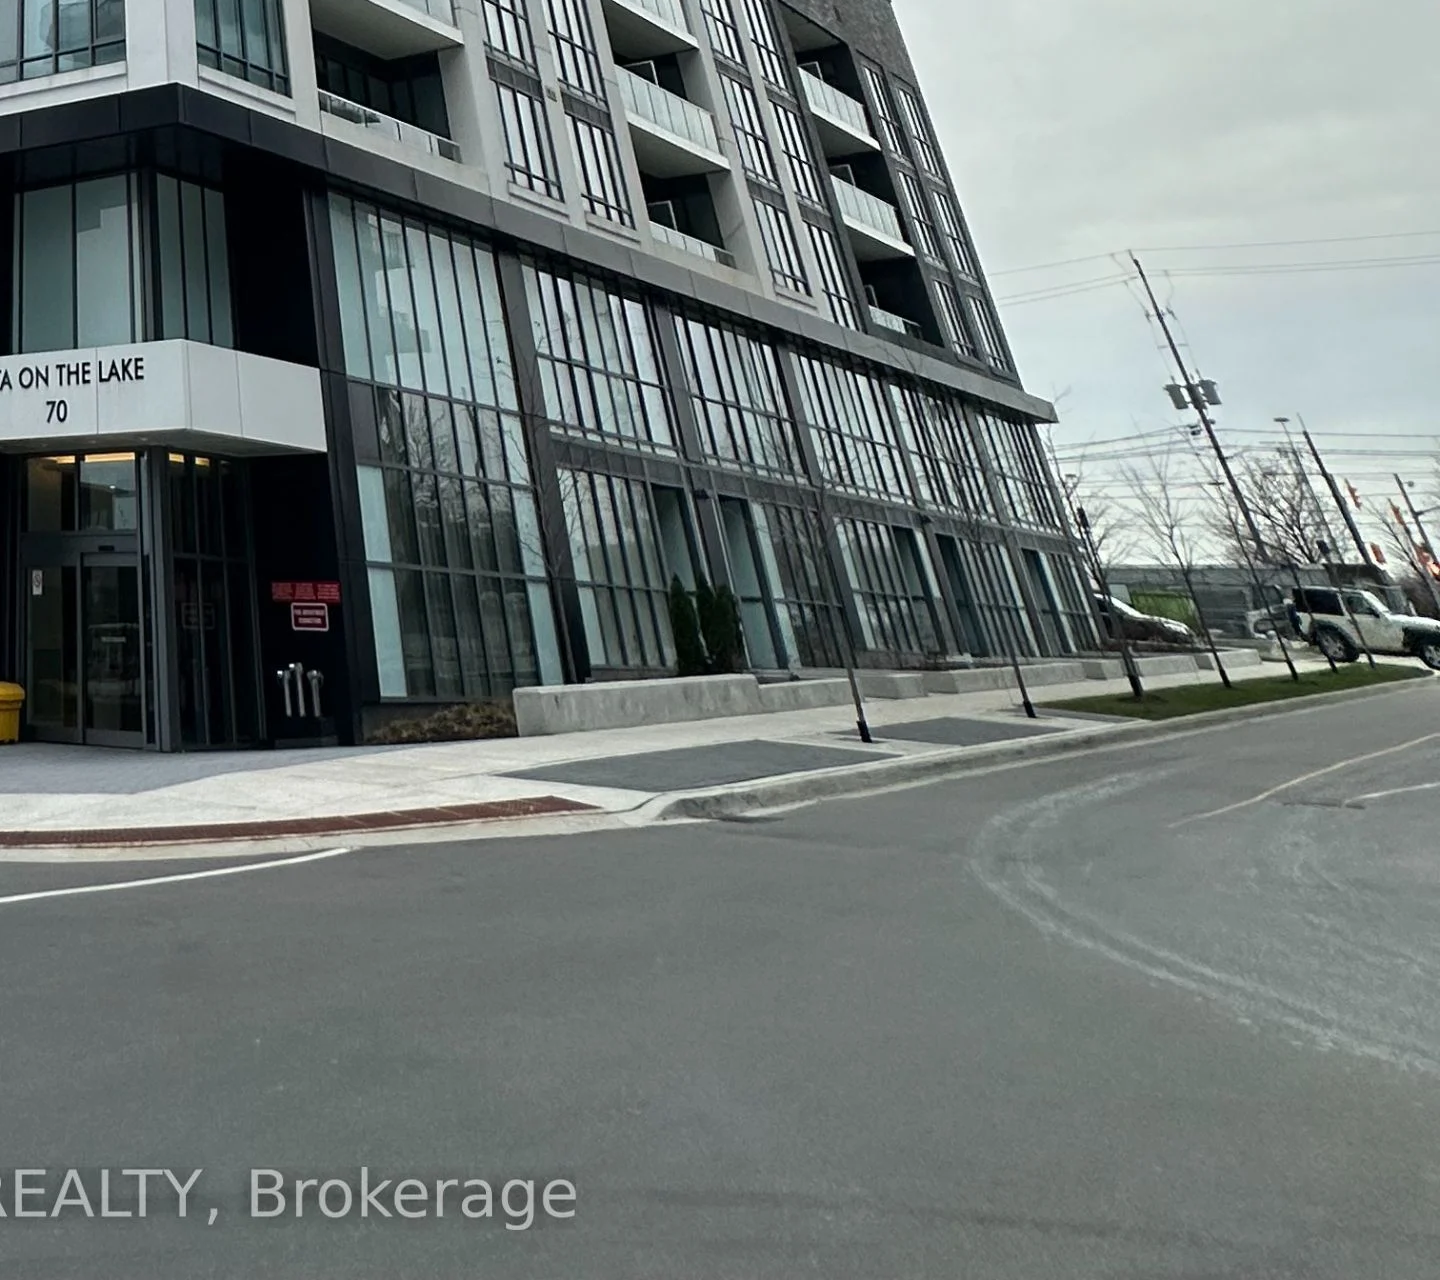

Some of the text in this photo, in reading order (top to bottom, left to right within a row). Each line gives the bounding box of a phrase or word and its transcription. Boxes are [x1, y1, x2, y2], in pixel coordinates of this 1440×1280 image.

[18, 365, 49, 389] ON
[56, 362, 91, 387] THE
[98, 357, 144, 383] LAKE
[46, 399, 68, 424] 70
